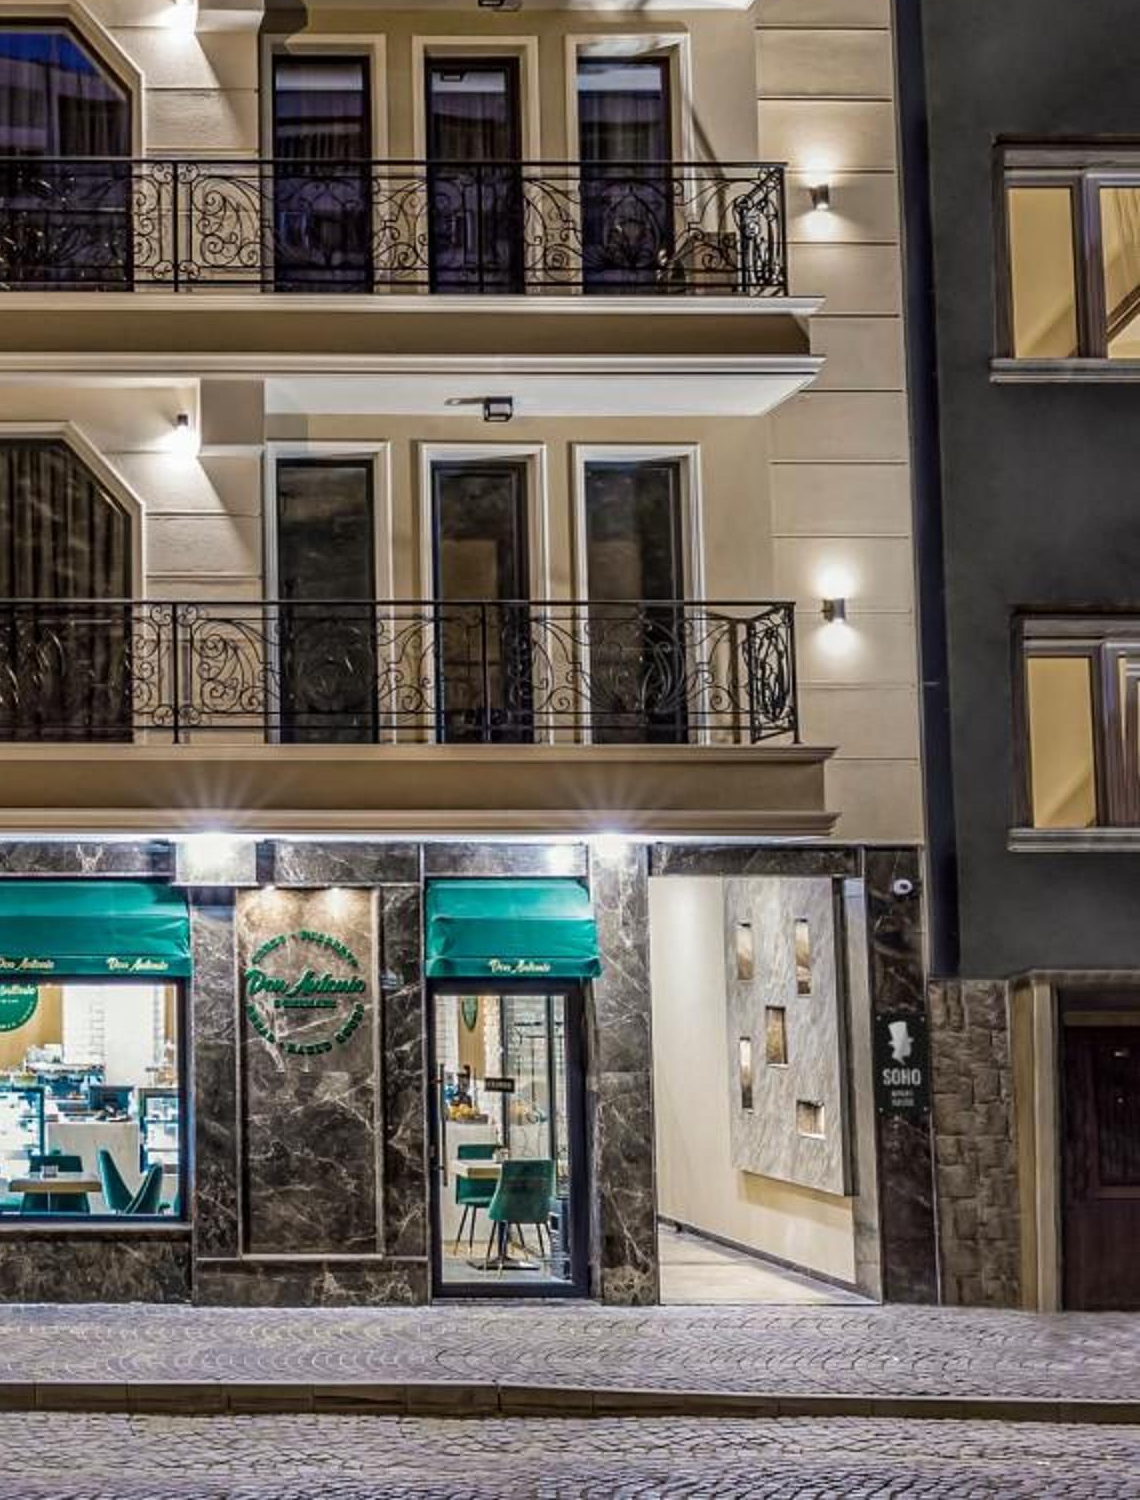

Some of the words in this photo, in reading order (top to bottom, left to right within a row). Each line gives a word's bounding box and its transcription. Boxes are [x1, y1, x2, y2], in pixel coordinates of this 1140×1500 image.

[14, 957, 55, 971] Antonio
[106, 957, 129, 971] Don
[128, 957, 169, 972] Antonio
[489, 959, 512, 973] Don
[510, 959, 551, 974] Antonio
[244, 967, 286, 996] Don
[284, 968, 366, 998] Antonio
[882, 1068, 921, 1086] SOHO
